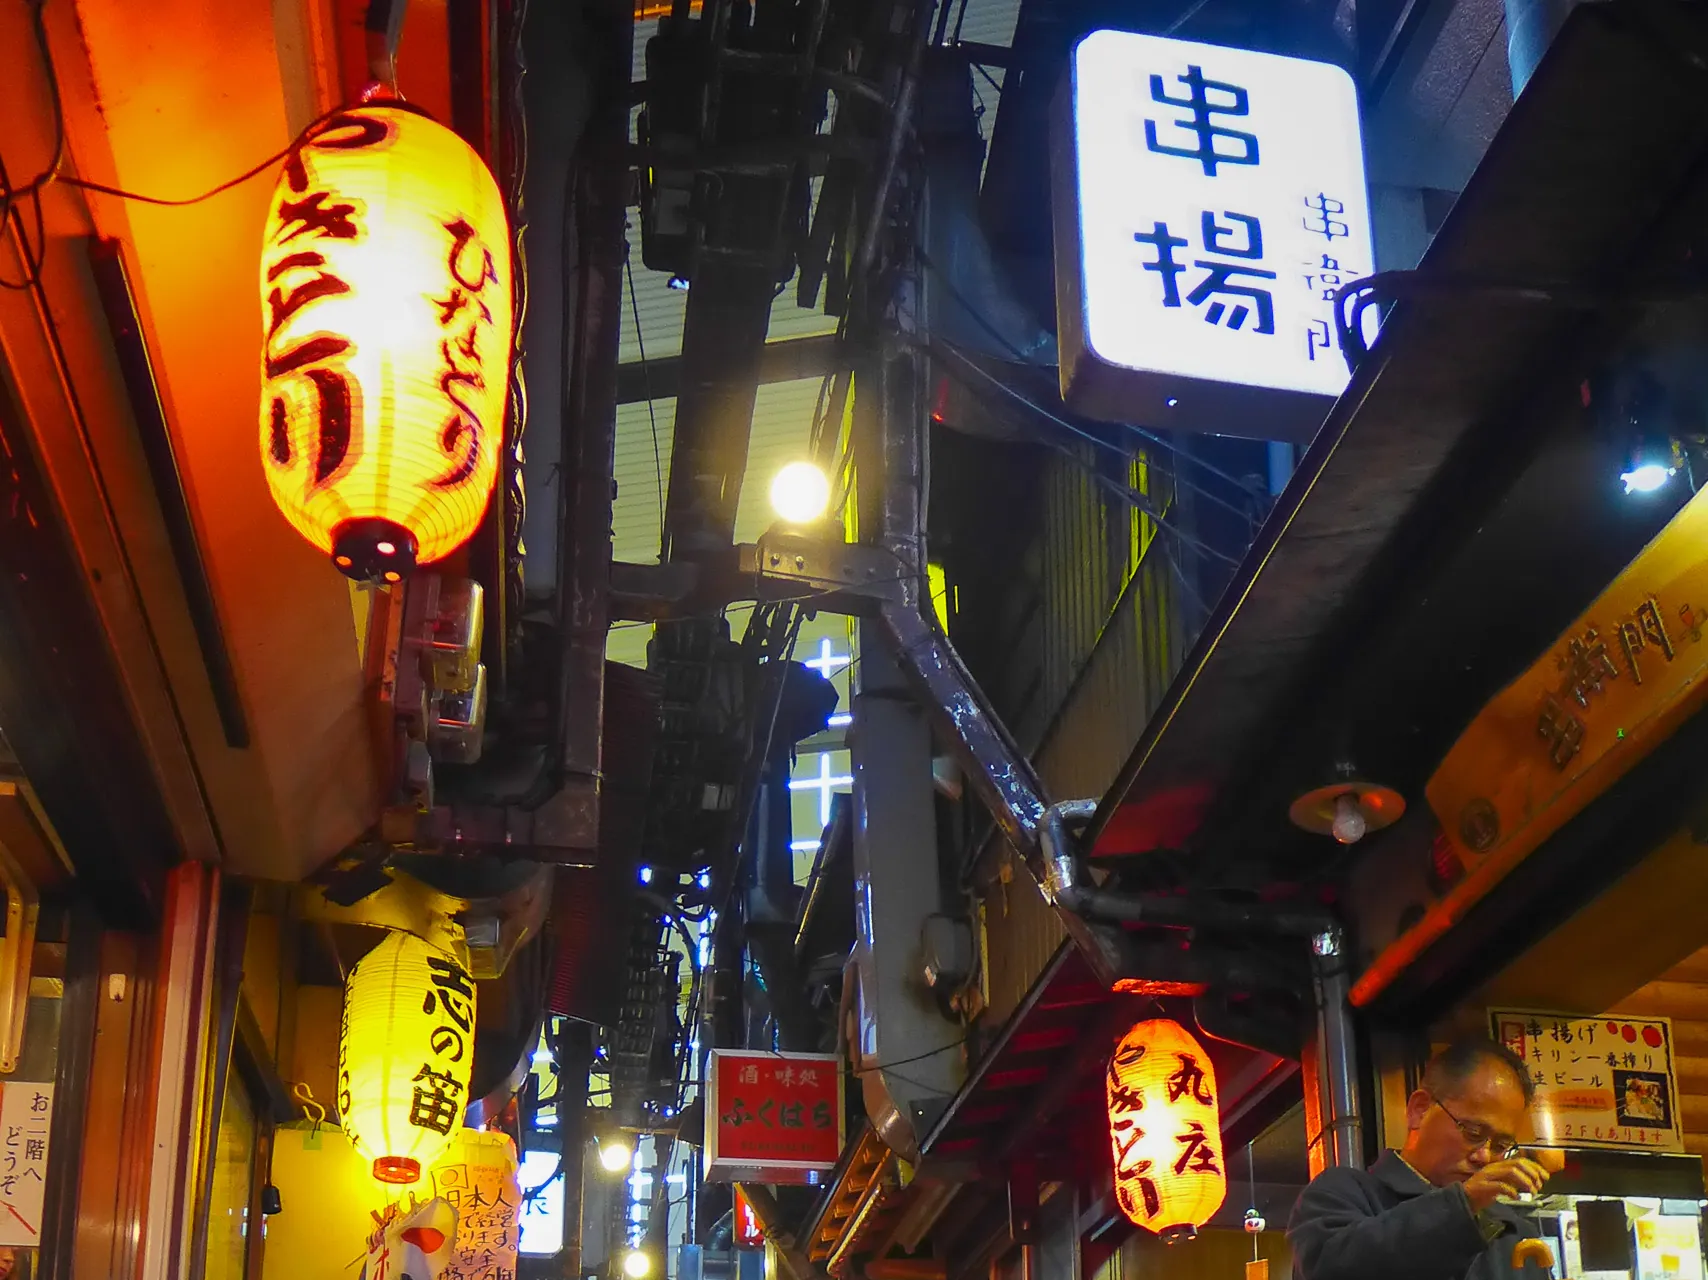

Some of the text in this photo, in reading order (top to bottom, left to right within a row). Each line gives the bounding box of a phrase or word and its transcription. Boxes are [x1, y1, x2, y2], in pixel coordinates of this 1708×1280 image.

[1134, 65, 1277, 335] 串揚
[266, 115, 388, 484] やきとり
[410, 956, 476, 1137] 志の笛
[1526, 1019, 1598, 1045] 串揚げ
[1532, 1047, 1653, 1070] キリン一番搾り
[1533, 1071, 1603, 1088] 生ビール
[0, 1126, 23, 1195] どうぞ
[23, 1092, 50, 1181] お二階へ
[1107, 1045, 1159, 1219] やきとり
[446, 1184, 514, 1212] 日本人
